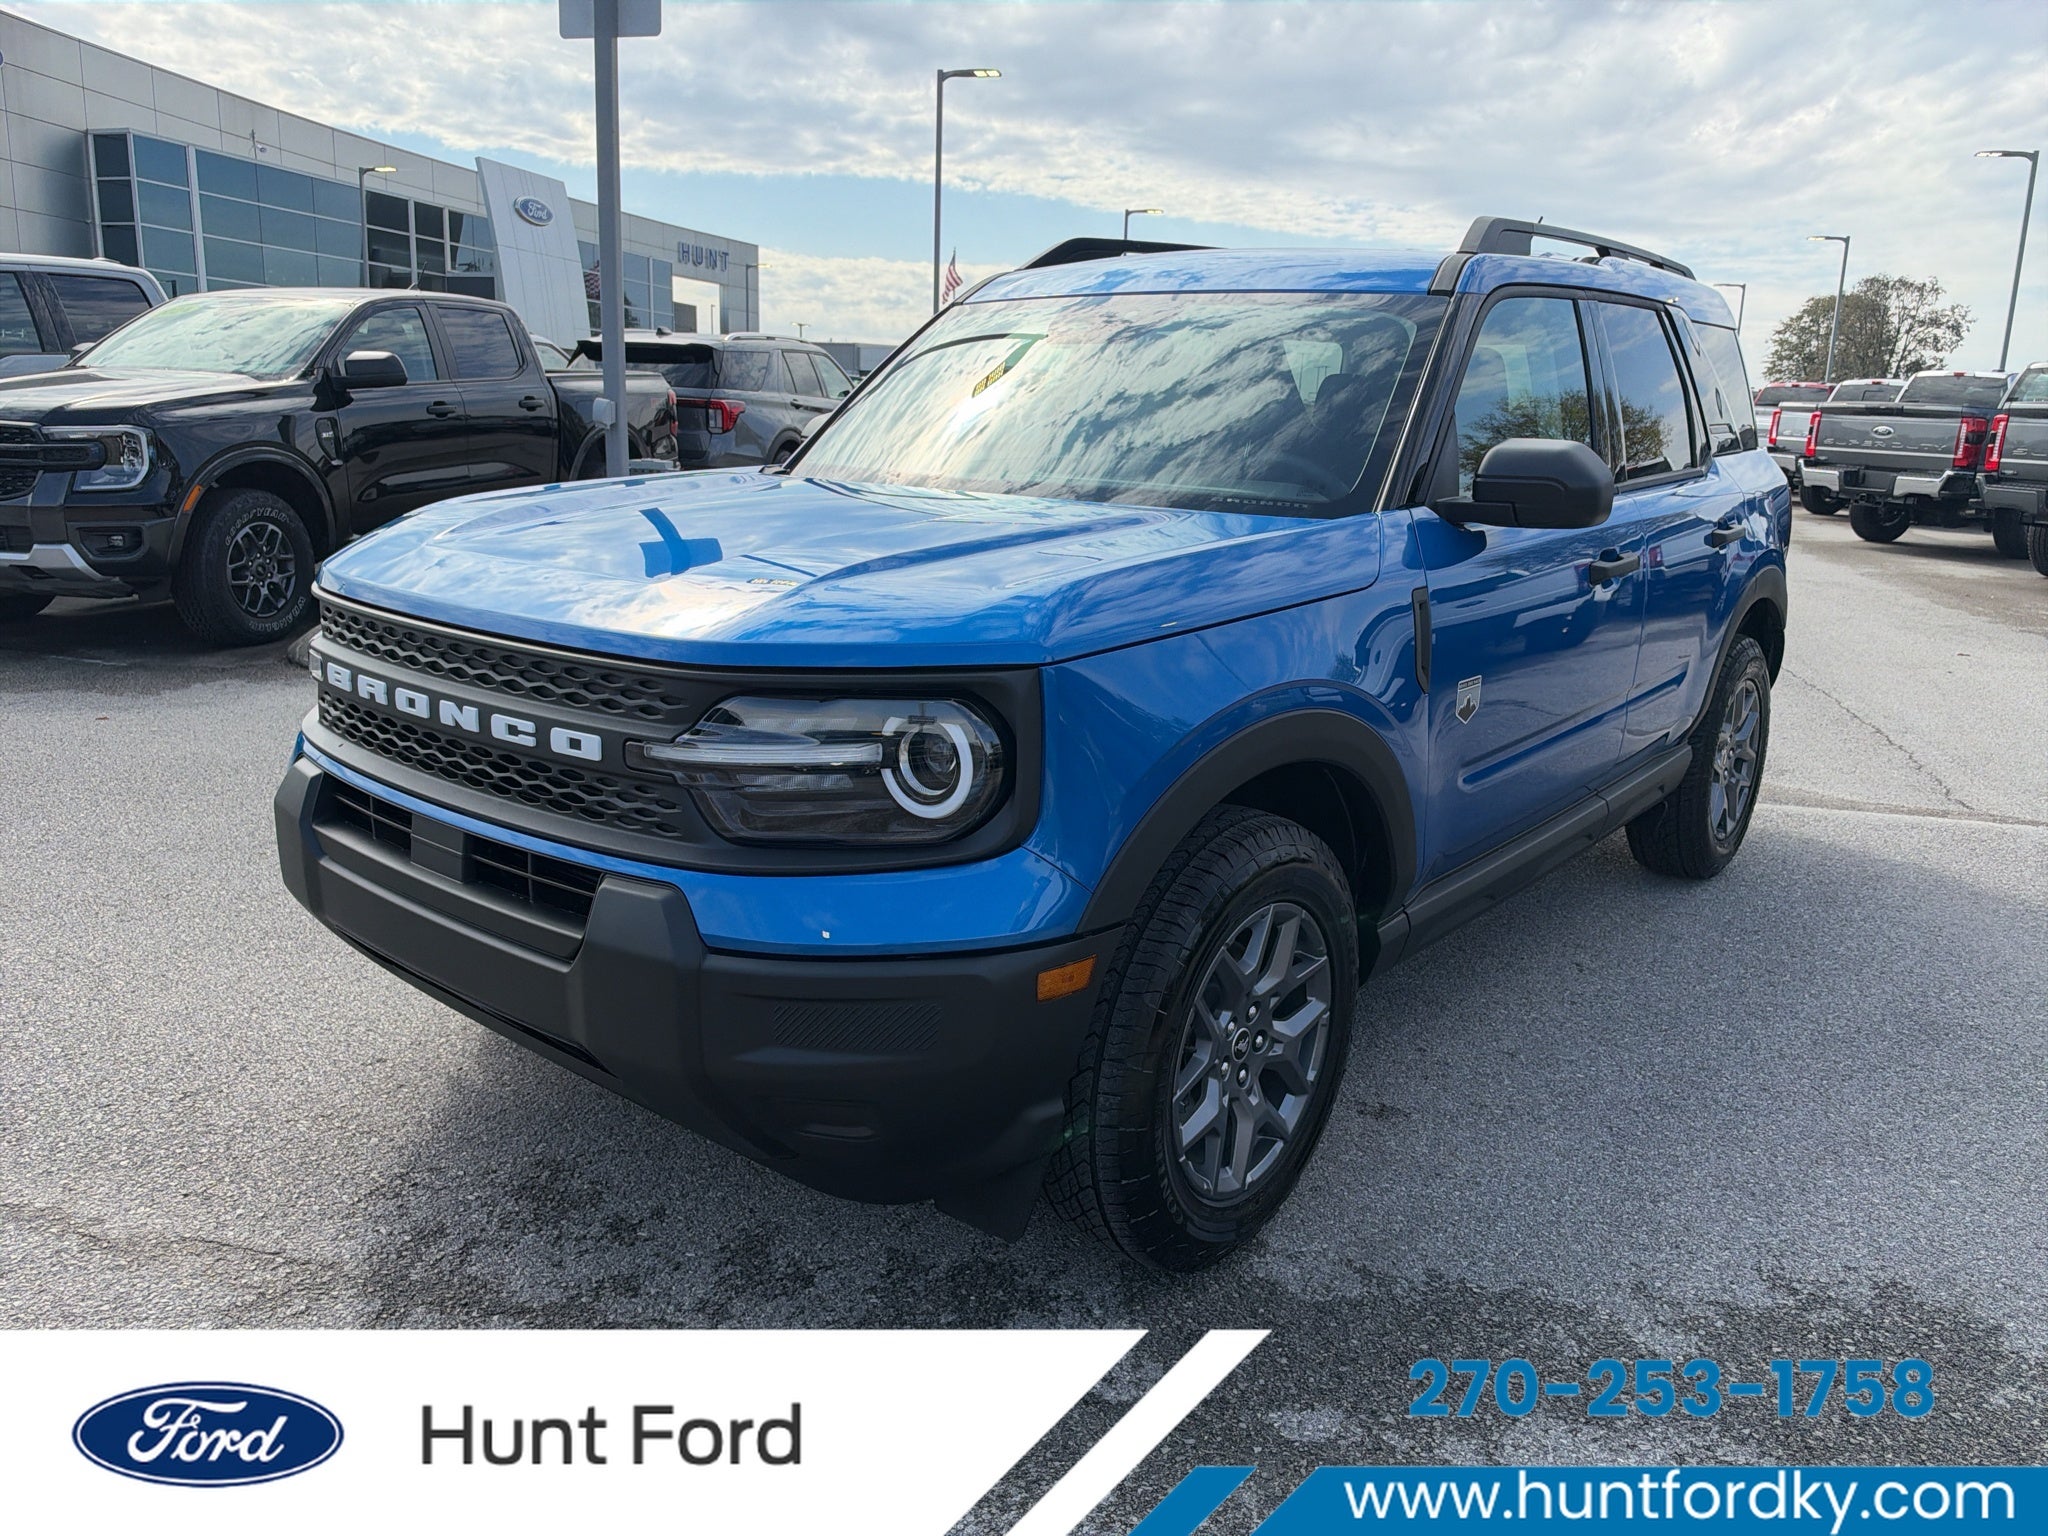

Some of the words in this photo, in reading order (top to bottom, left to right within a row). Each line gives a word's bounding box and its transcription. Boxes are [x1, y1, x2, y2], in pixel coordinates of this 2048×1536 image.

[678, 241, 730, 273] HUNT
[1823, 438, 1886, 449] SUPER
[1891, 442, 1947, 451] DUTY
[225, 506, 291, 546] GOODYEAR
[327, 661, 603, 762] BRONCO
